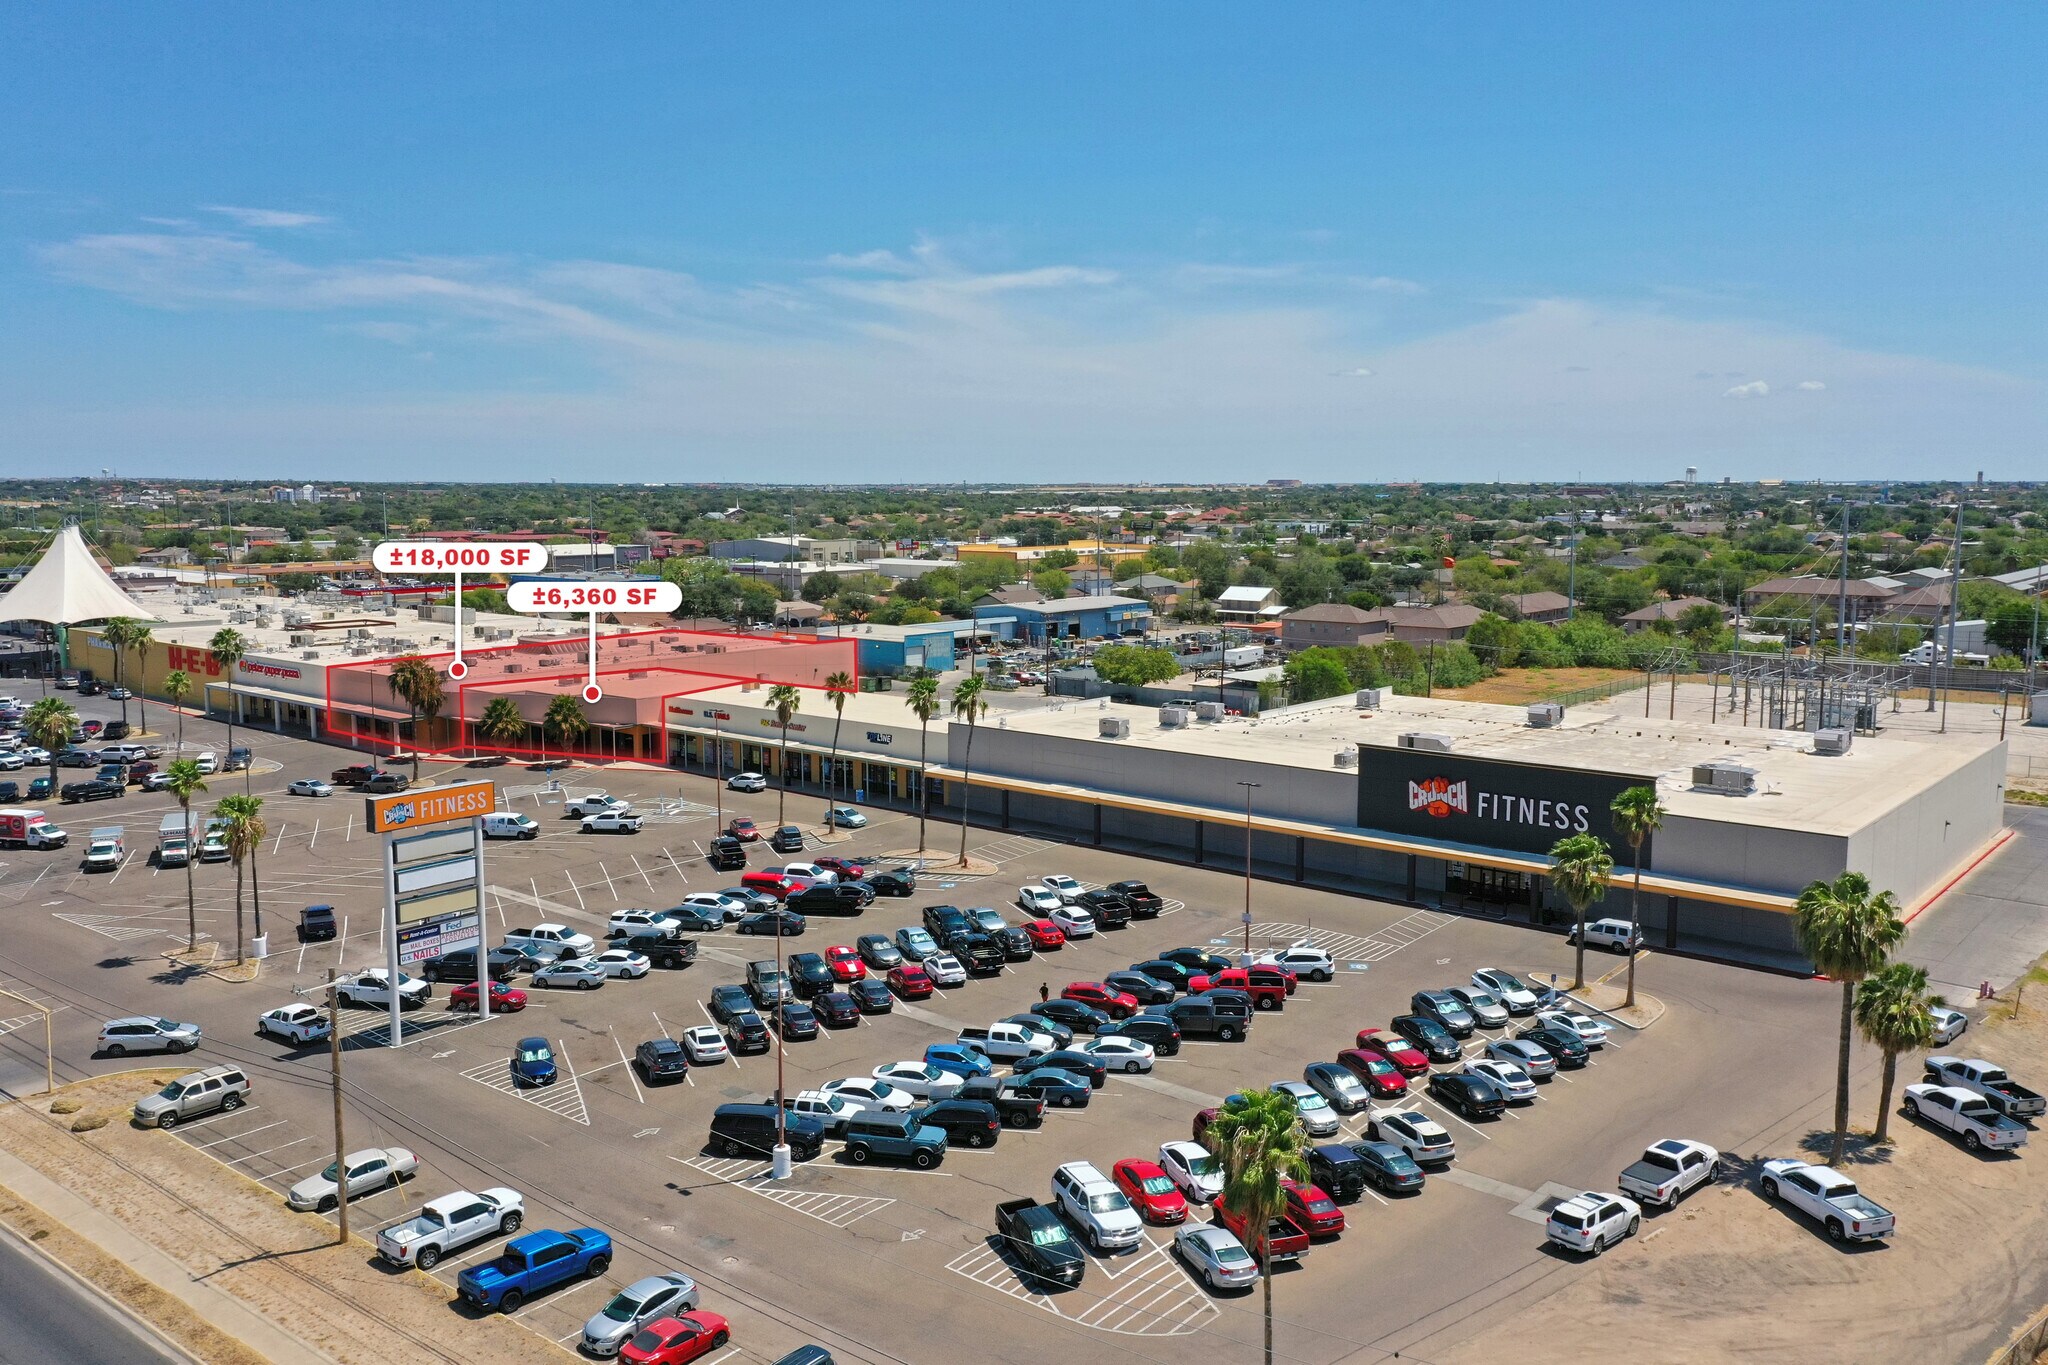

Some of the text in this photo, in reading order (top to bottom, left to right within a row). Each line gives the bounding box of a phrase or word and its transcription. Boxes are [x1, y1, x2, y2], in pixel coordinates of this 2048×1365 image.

[383, 791, 487, 825] CRUNCH FITNESS
[1408, 780, 1589, 832] CRUNCH FITNESS
[409, 926, 439, 939] Rent-A-Center
[410, 941, 422, 950] MAIL
[423, 937, 440, 947] BOXES
[401, 954, 412, 962] U.S.
[413, 947, 440, 961] NAILS
